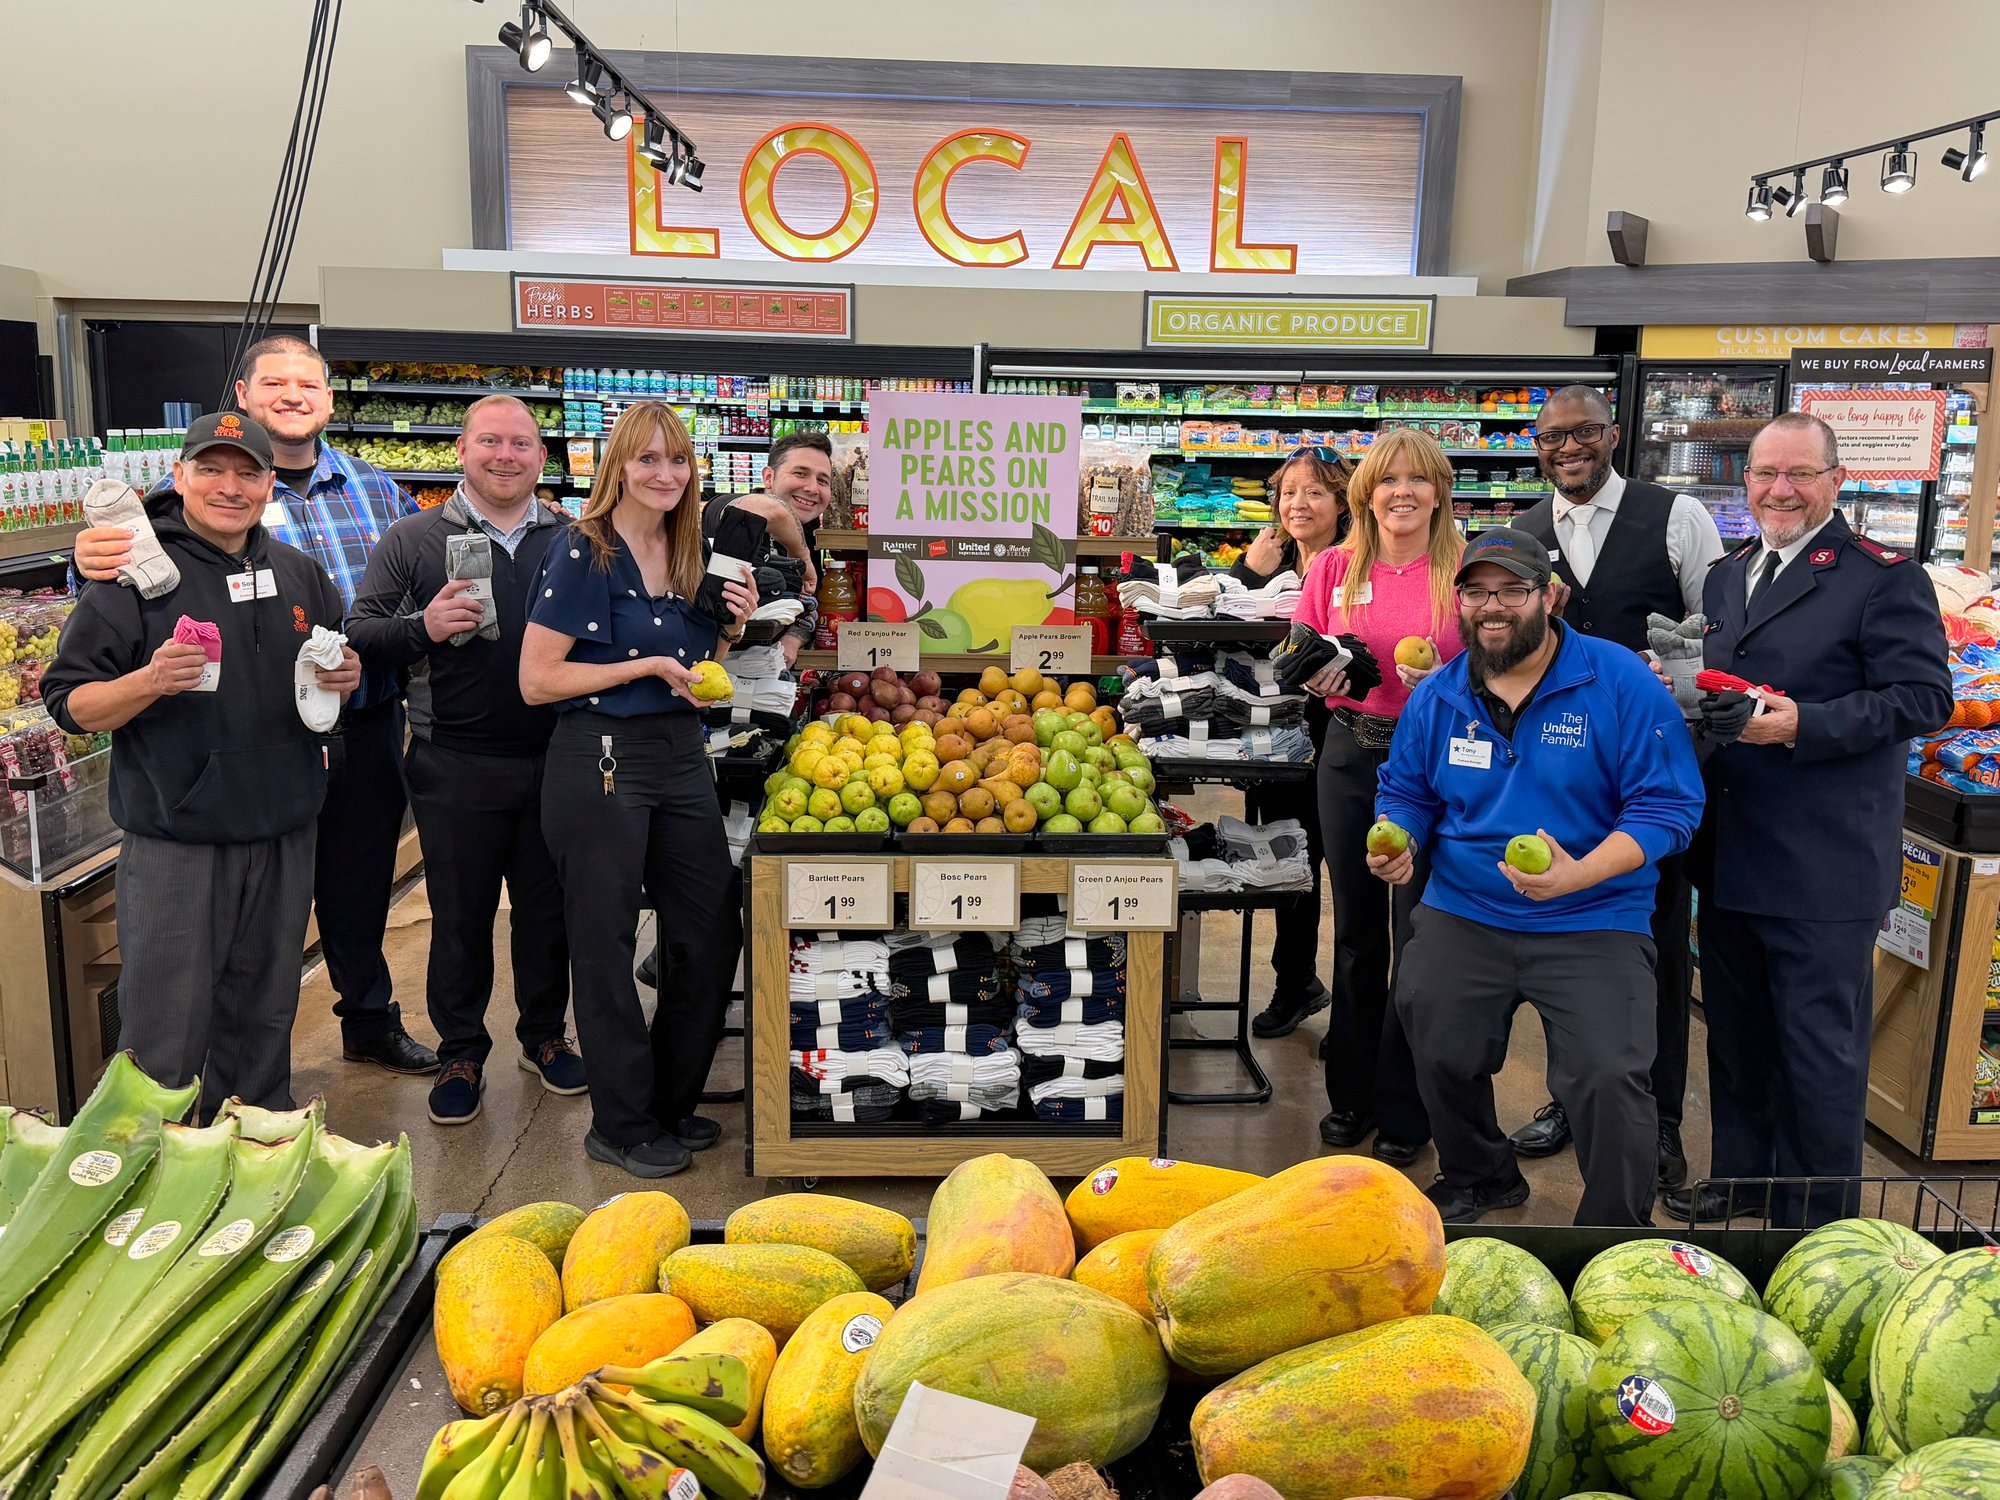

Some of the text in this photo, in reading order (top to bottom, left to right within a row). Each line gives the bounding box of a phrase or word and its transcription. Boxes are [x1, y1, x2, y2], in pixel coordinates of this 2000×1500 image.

[628, 116, 1298, 274] LOCAL
[525, 286, 561, 304] Fresh
[526, 304, 594, 320] HERBS
[1167, 312, 1408, 335] ORGANIC PRODUCE
[1716, 326, 1929, 344] CUSTOM CAKES
[1800, 351, 1986, 374] WE BUY FROM Local FARMERS
[1848, 407, 1870, 426] long
[1873, 408, 1904, 427] happy
[1908, 406, 1926, 424] life
[882, 418, 1066, 454] APPLES AND
[900, 454, 1047, 489] PEARS ON
[1508, 482, 1544, 492] ORGANIC
[895, 489, 1051, 524] A MISSION
[1092, 494, 1106, 503] TRAIL
[1093, 518, 1111, 532] $10
[882, 541, 918, 551] Rainier
[958, 542, 990, 552] United
[1006, 544, 1031, 553] Market
[1814, 552, 1830, 562] S
[867, 647, 892, 667] 1 99
[1038, 650, 1064, 670] 2 99
[1562, 712, 1583, 724] The
[1542, 722, 1582, 735] United
[1462, 746, 1477, 756] Tony
[1902, 843, 1932, 865] PECIAL
[1113, 876, 1138, 884] Anjou
[1901, 876, 1916, 893] 3 49
[824, 896, 855, 920] 1 99
[951, 895, 982, 920] 1 99
[1107, 896, 1138, 920] 1 99
[71, 1172, 104, 1184] Aloe Vera
